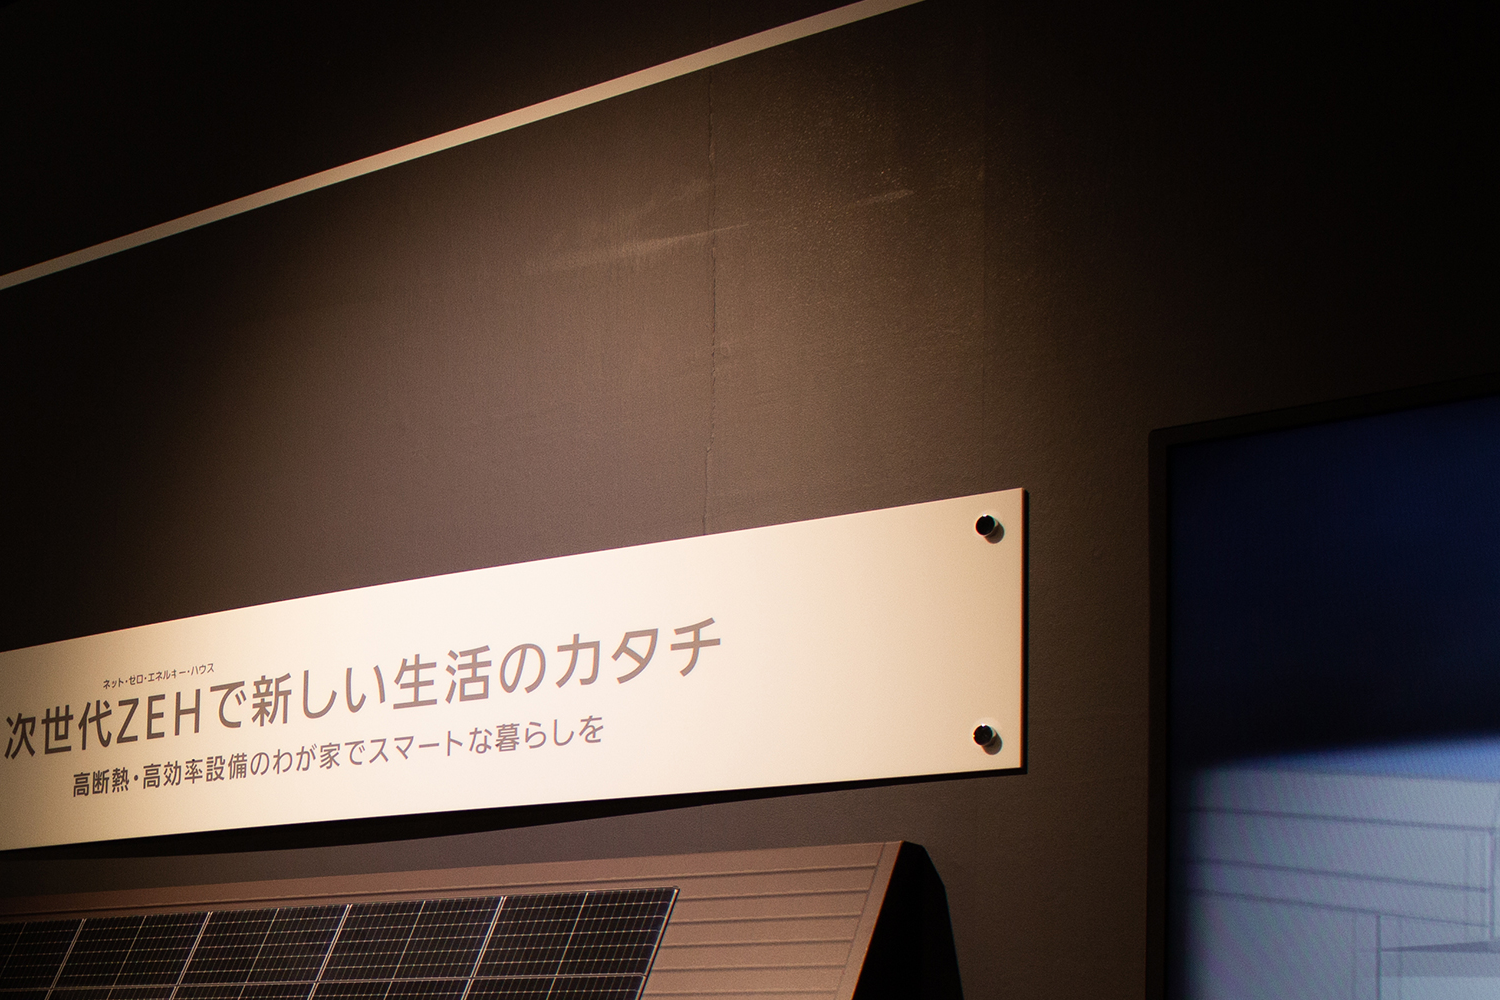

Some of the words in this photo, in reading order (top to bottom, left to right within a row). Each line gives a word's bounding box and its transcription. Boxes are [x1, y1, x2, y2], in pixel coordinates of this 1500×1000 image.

[4, 617, 721, 760] 次世代ZEHで新しい生活のカタチ
[72, 715, 604, 798] 高断熱・高効率設備のわが家でスマートな暮らしを
